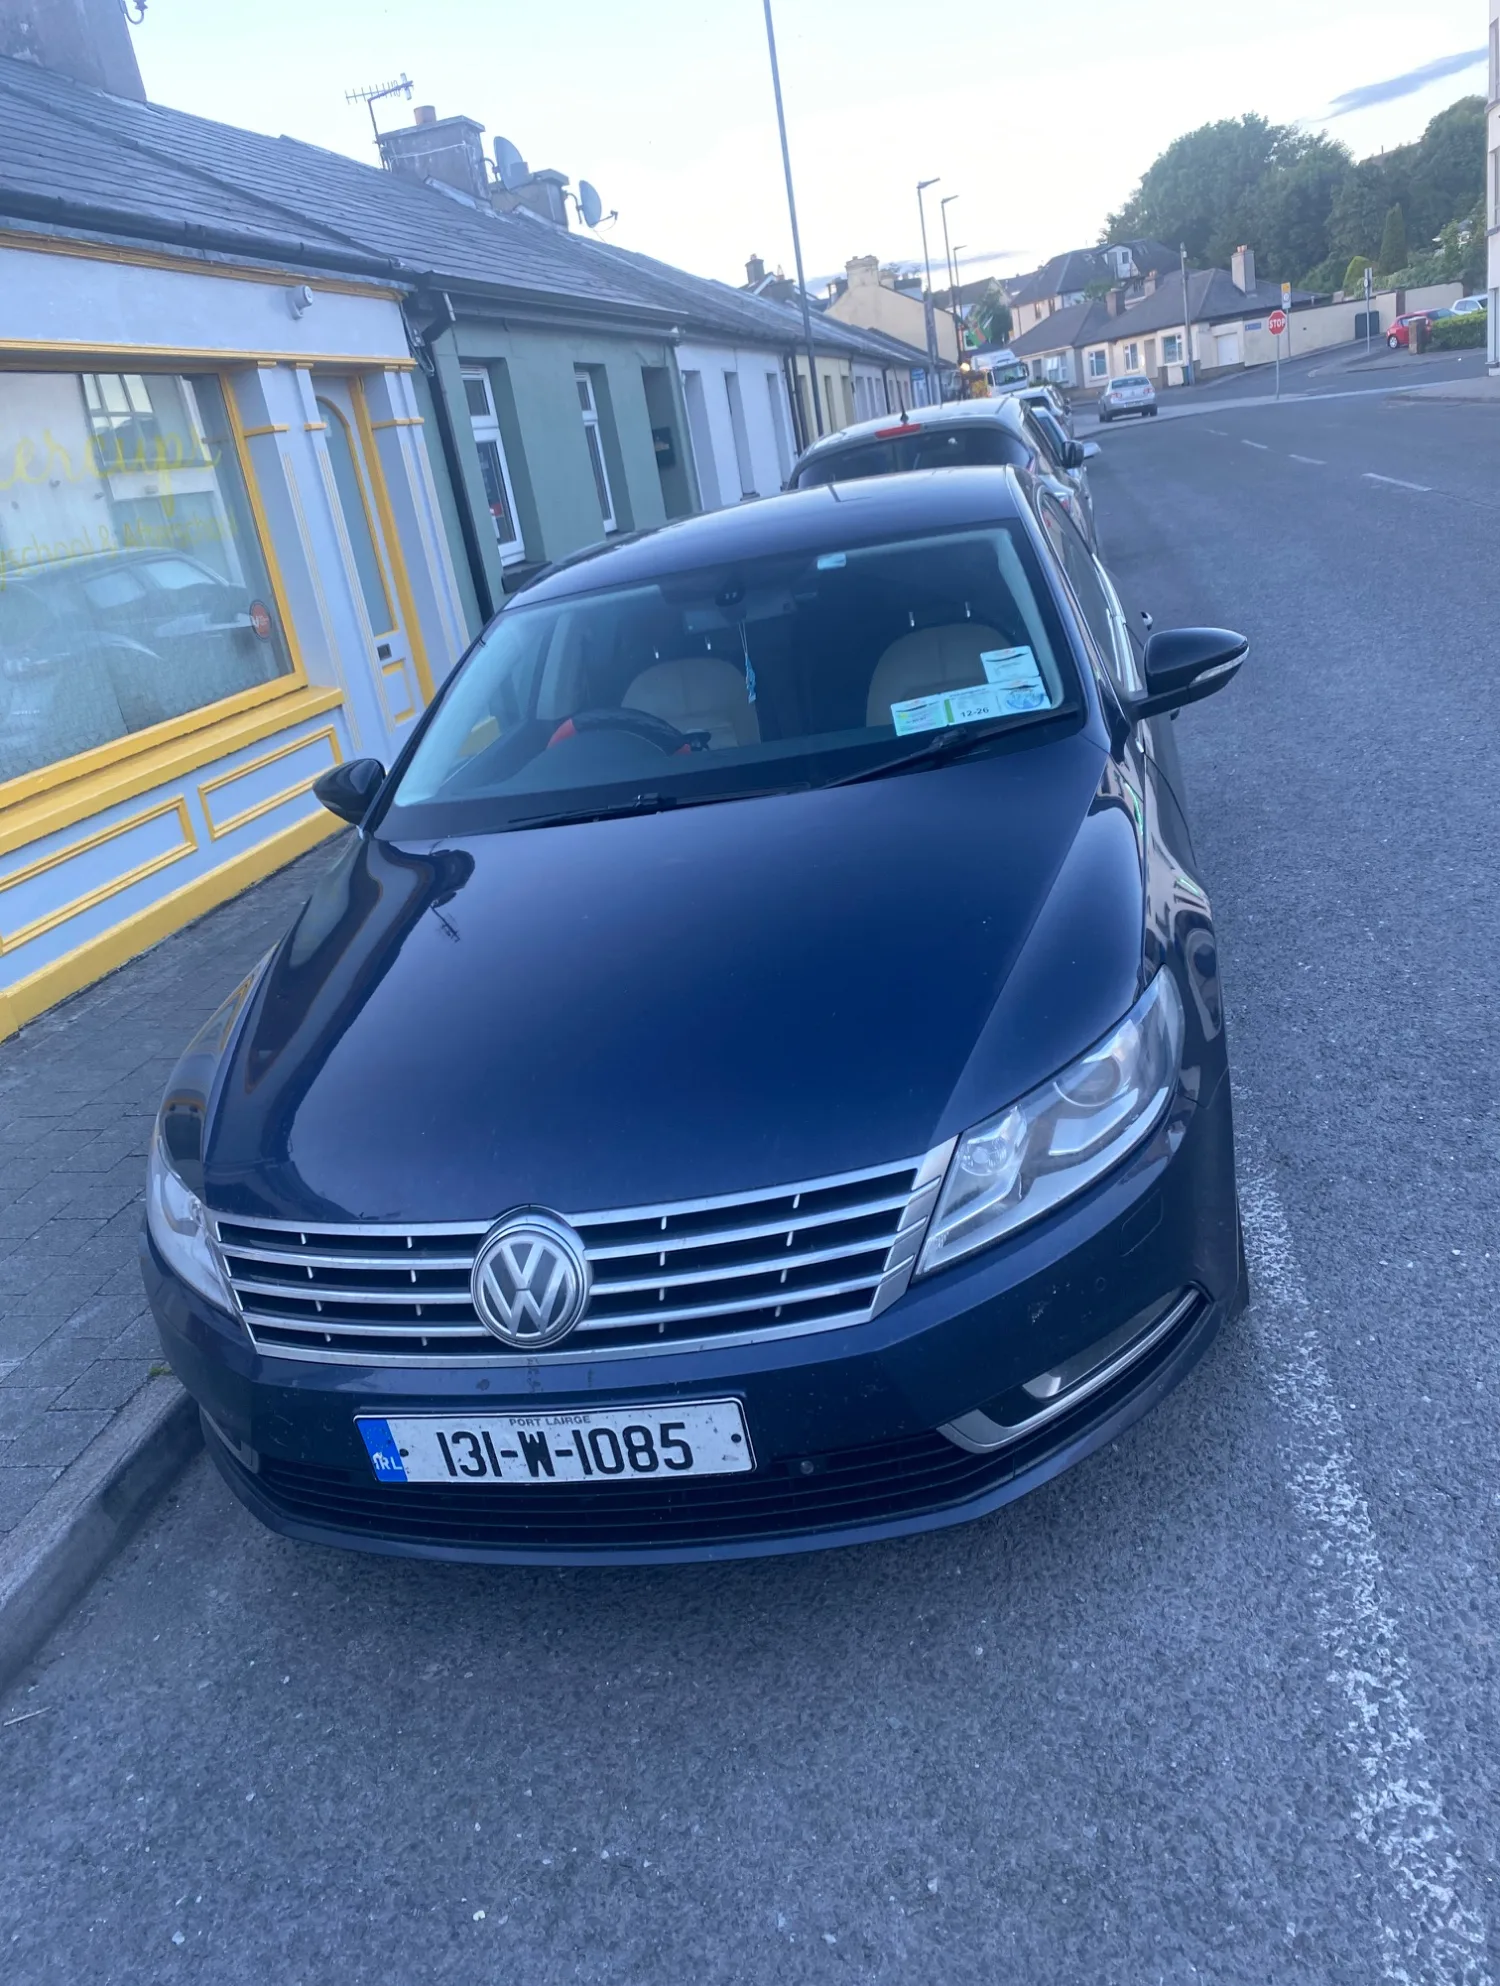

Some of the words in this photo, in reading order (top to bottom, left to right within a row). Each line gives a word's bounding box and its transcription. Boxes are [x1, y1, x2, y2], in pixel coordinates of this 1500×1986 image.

[1269, 318, 1286, 329] STOP
[960, 707, 990, 718] 12-26
[508, 1418, 541, 1426] PORT
[545, 1415, 591, 1425] LAIRGE
[436, 1422, 694, 1477] 131-W-1085
[373, 1453, 403, 1471] IRL
